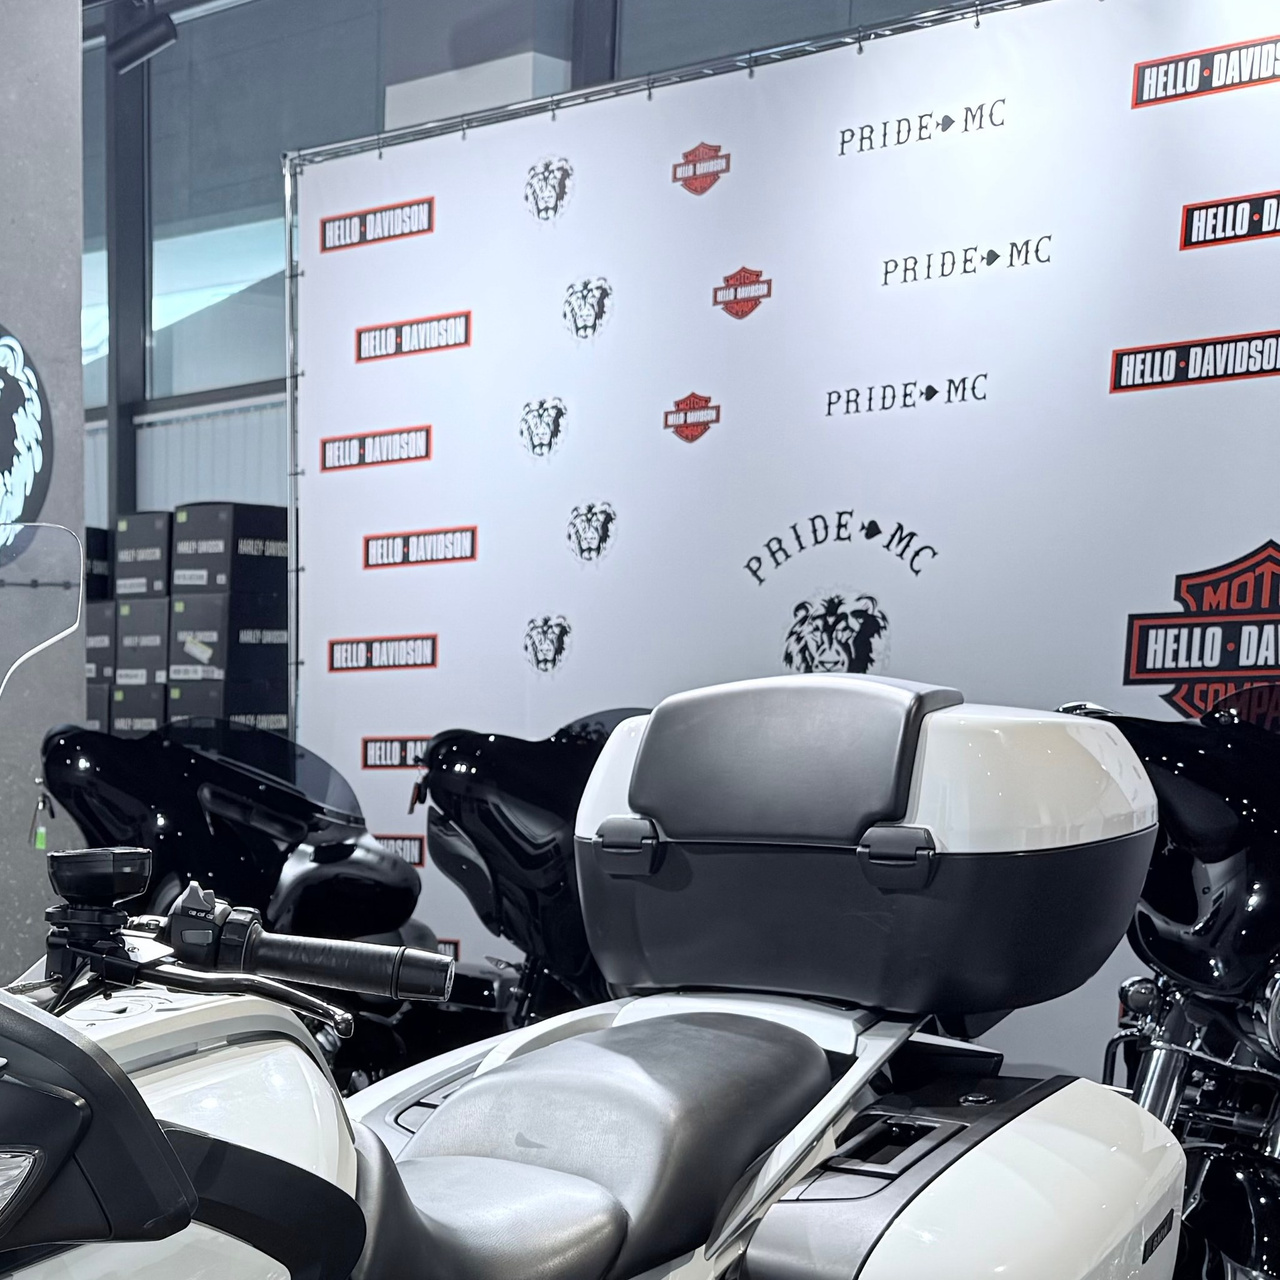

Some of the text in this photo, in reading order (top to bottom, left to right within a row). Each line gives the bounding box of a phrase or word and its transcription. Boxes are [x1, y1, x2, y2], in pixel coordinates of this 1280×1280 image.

[1142, 42, 1280, 101] HELLO DAVID
[838, 98, 1006, 156] PRIDE MC
[325, 202, 429, 248] HELLO DAVIDSON
[1191, 202, 1251, 243] HELLO
[881, 234, 1052, 286] PRIDE MC
[360, 315, 466, 358] HELLO DAVIDSON
[1120, 337, 1280, 387] HELLO DAVIDSO
[825, 373, 988, 416] PRIDE MC
[325, 430, 427, 468] HELLO DAVIDSON
[368, 531, 472, 566] HELLO DAVIDSON
[743, 509, 938, 587] PRIDE MC
[333, 638, 433, 669] HELLO DAVIDSON
[1145, 626, 1223, 669] HELLO
[366, 740, 401, 766] HELLO
